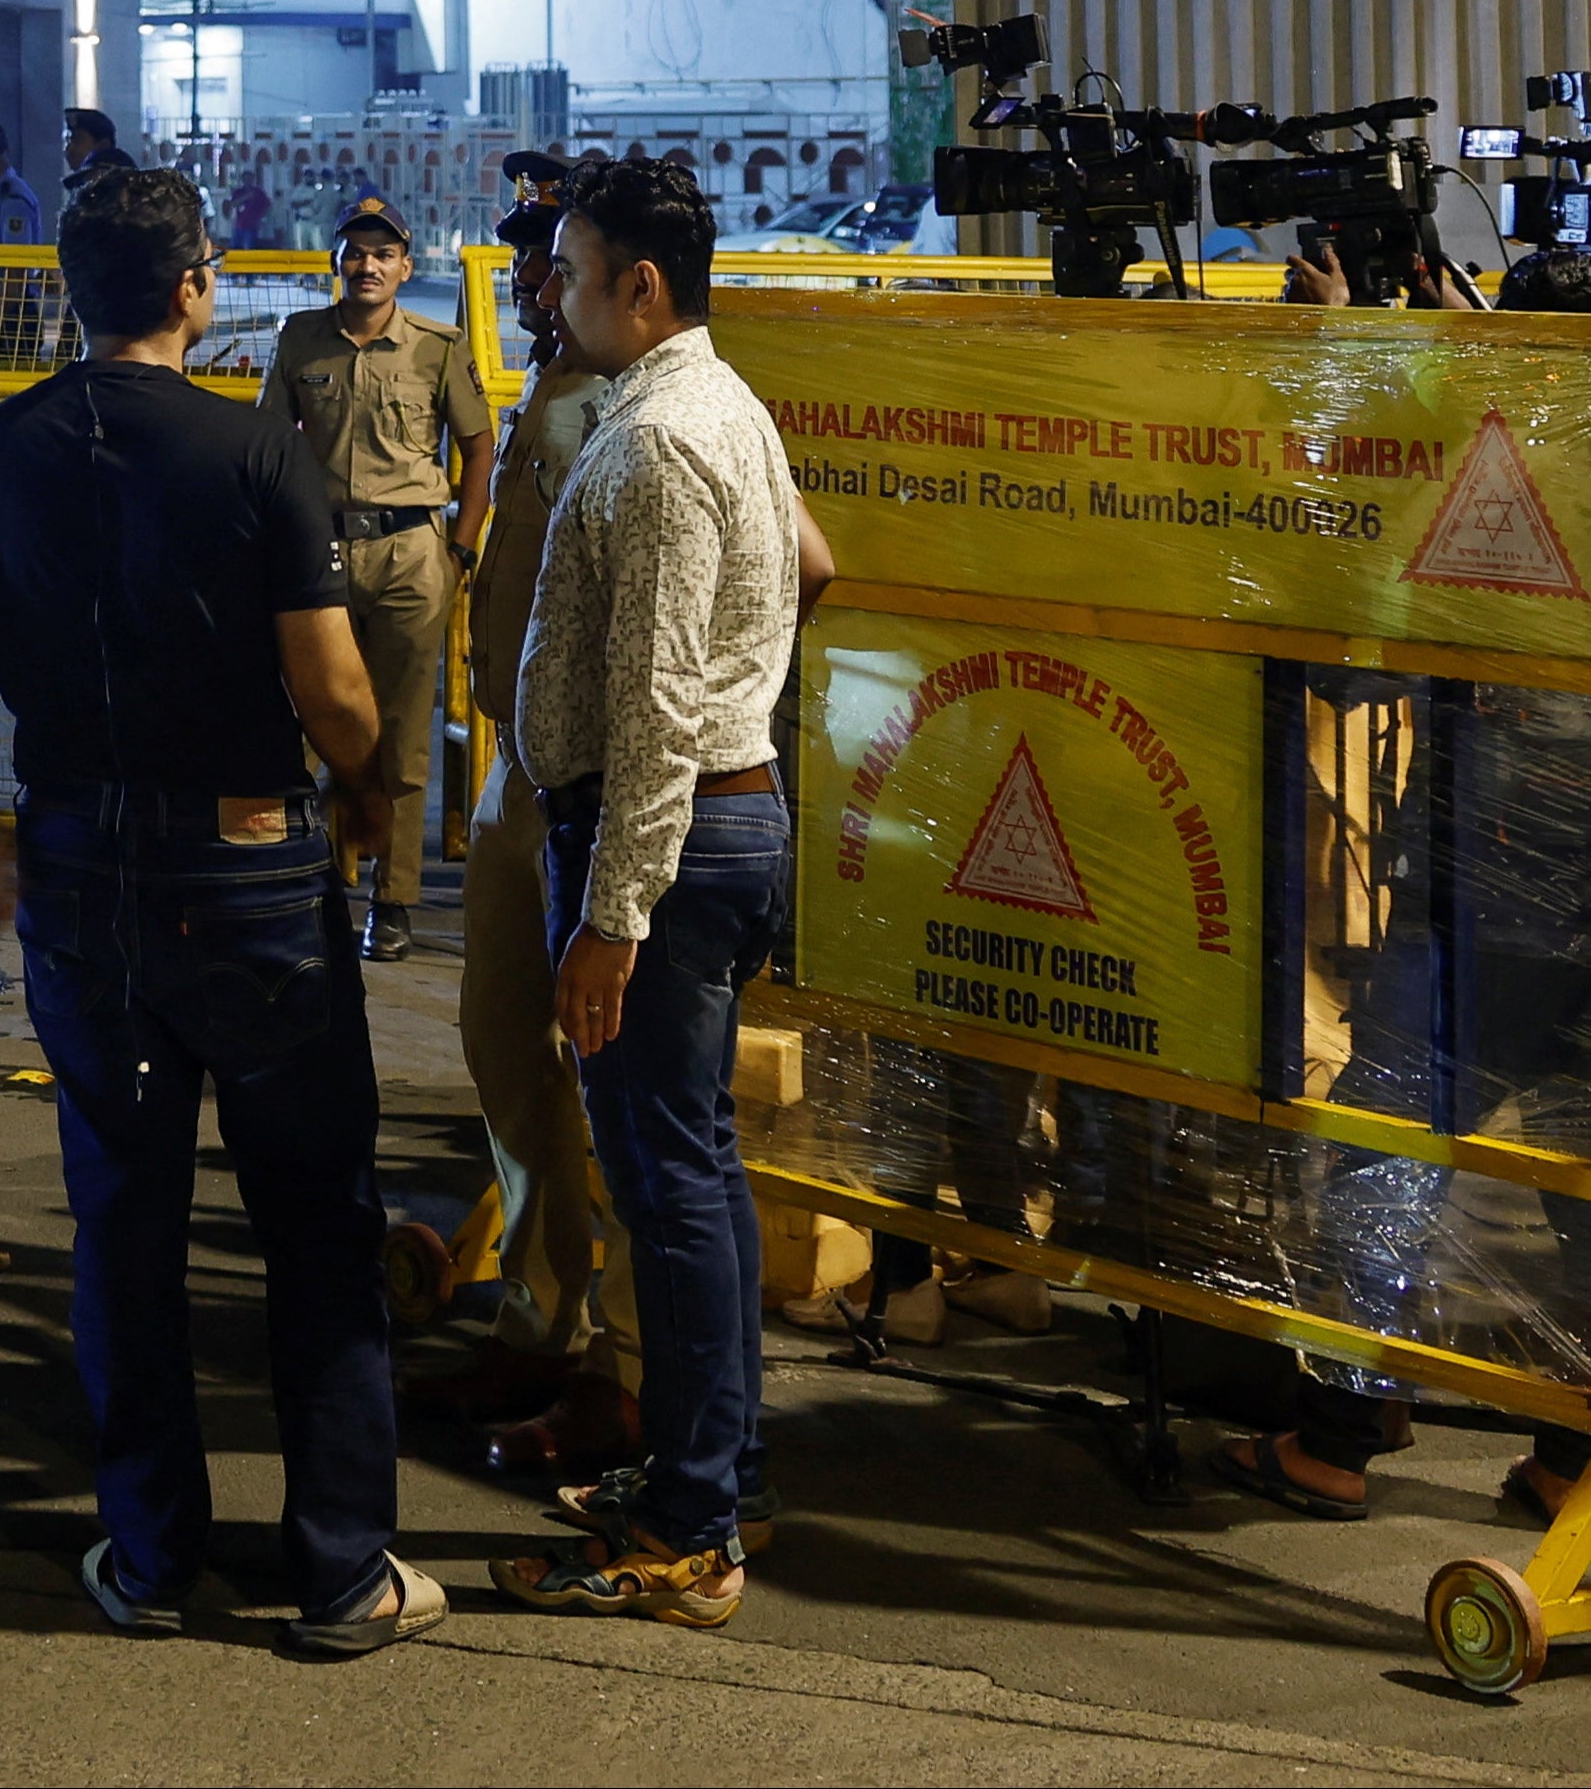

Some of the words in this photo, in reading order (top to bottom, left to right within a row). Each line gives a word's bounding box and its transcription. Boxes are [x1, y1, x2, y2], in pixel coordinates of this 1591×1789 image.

[995, 412, 1132, 460] TEMPLE
[1143, 423, 1271, 477] TRUST,
[1282, 431, 1443, 482] MUMBAI
[879, 463, 968, 506] Desai
[979, 471, 1075, 521] Road,
[1089, 479, 1383, 542] Mumbai-400026
[1004, 649, 1112, 720] TEMPLE
[850, 650, 1001, 804] MAHALAKSHMI
[1109, 695, 1190, 810] TRUST,
[837, 800, 873, 883] SHRI
[1171, 803, 1231, 956] MUMBAI
[925, 919, 1045, 977] SECURITY
[1050, 945, 1138, 998] CHECK
[914, 968, 999, 1020] PLEASE
[1004, 988, 1160, 1056] CO-OPERATE
